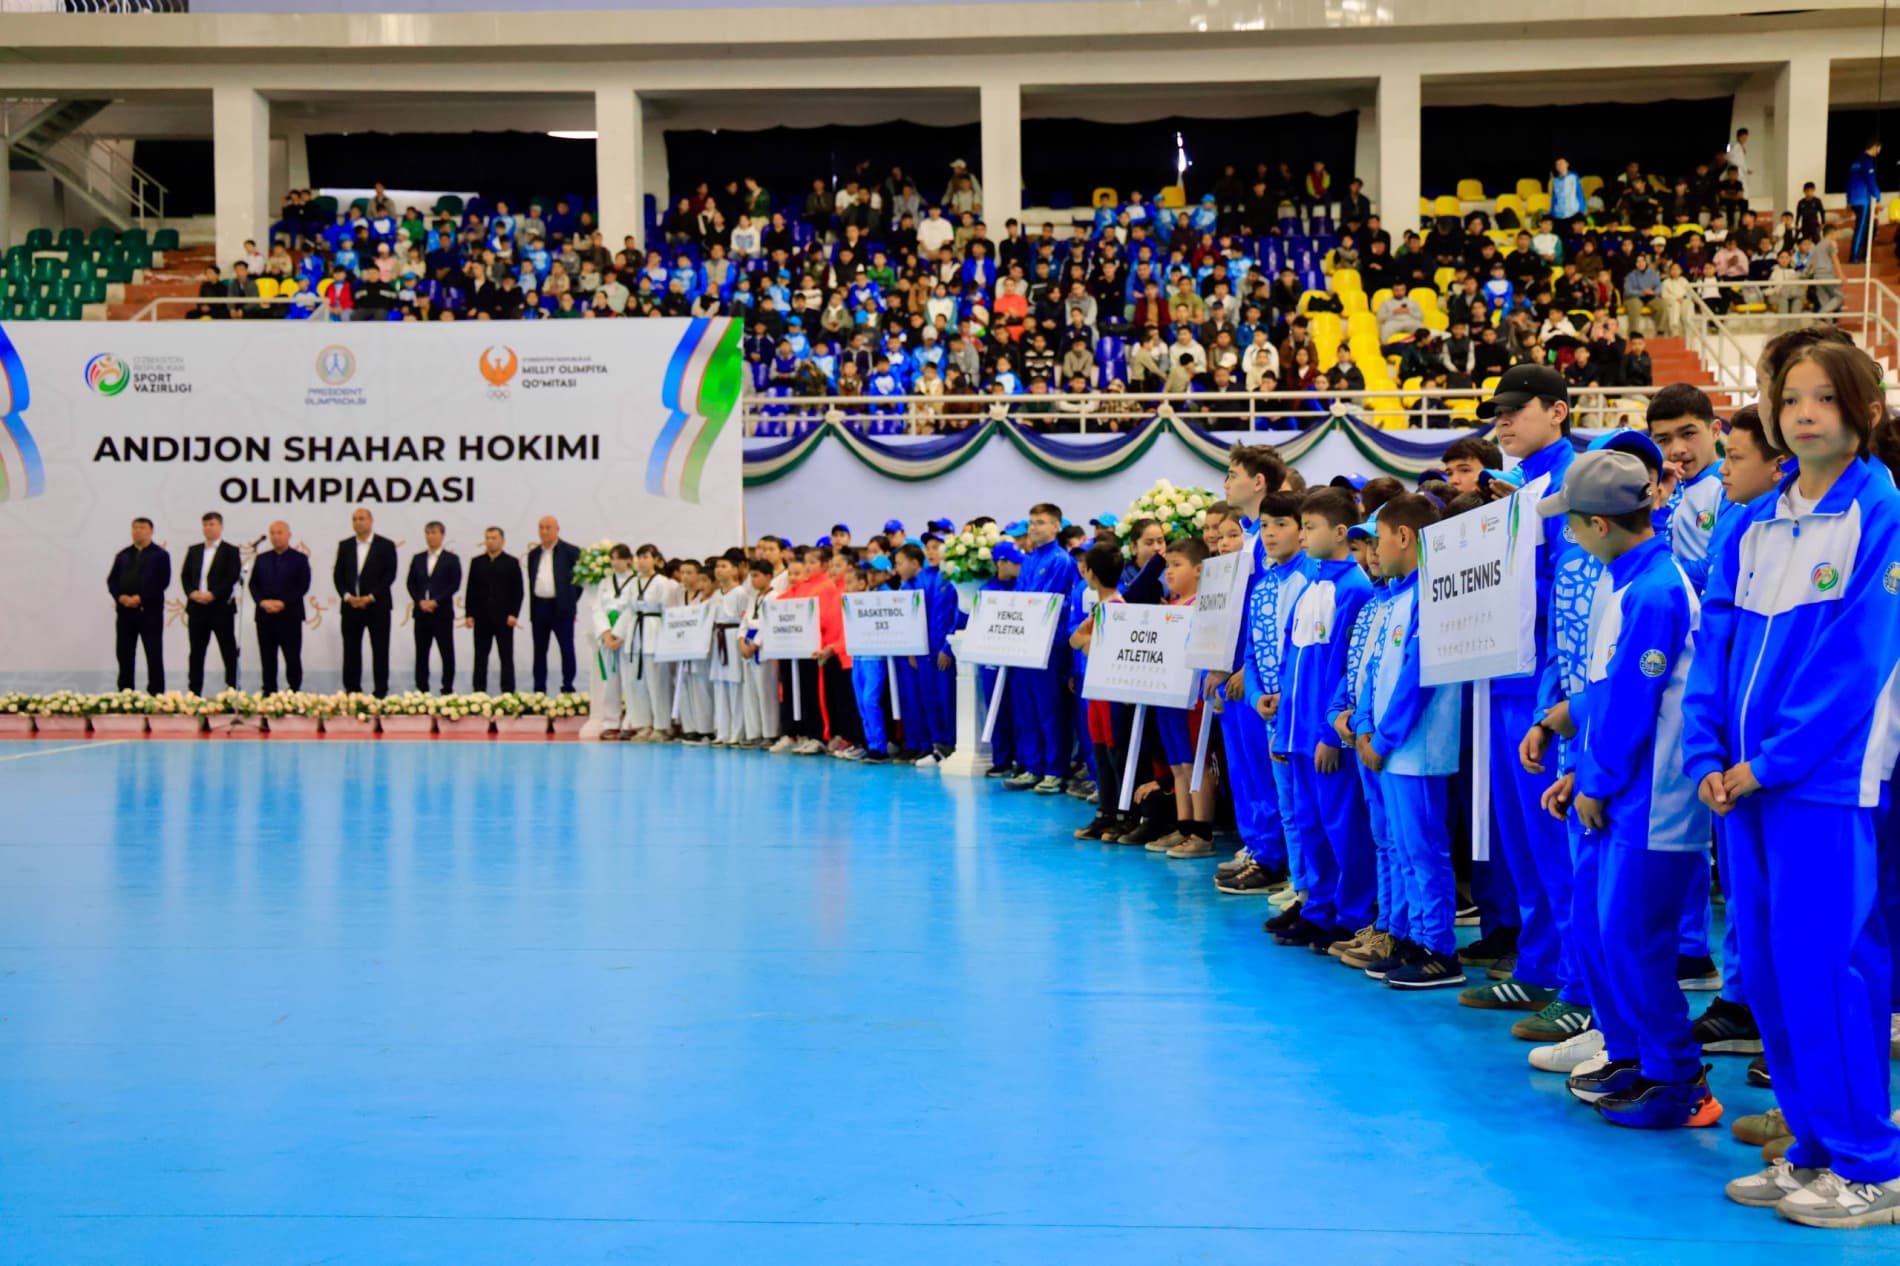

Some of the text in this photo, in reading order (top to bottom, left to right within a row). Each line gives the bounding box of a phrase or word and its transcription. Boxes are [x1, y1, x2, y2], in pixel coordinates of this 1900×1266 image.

[522, 365, 555, 374] MILLIY
[134, 373, 172, 382] SPORT
[134, 383, 192, 393] VAZIRLIGI
[93, 434, 600, 463] ANDIJON SHAHAR HOKIMI
[219, 477, 474, 504] OLIMPIADASI
[1432, 559, 1501, 602] STOL TENNIS
[857, 608, 904, 618] BASKETBOL
[988, 624, 1025, 635] ATLETIKA
[1117, 649, 1164, 664] ATLETIKA
